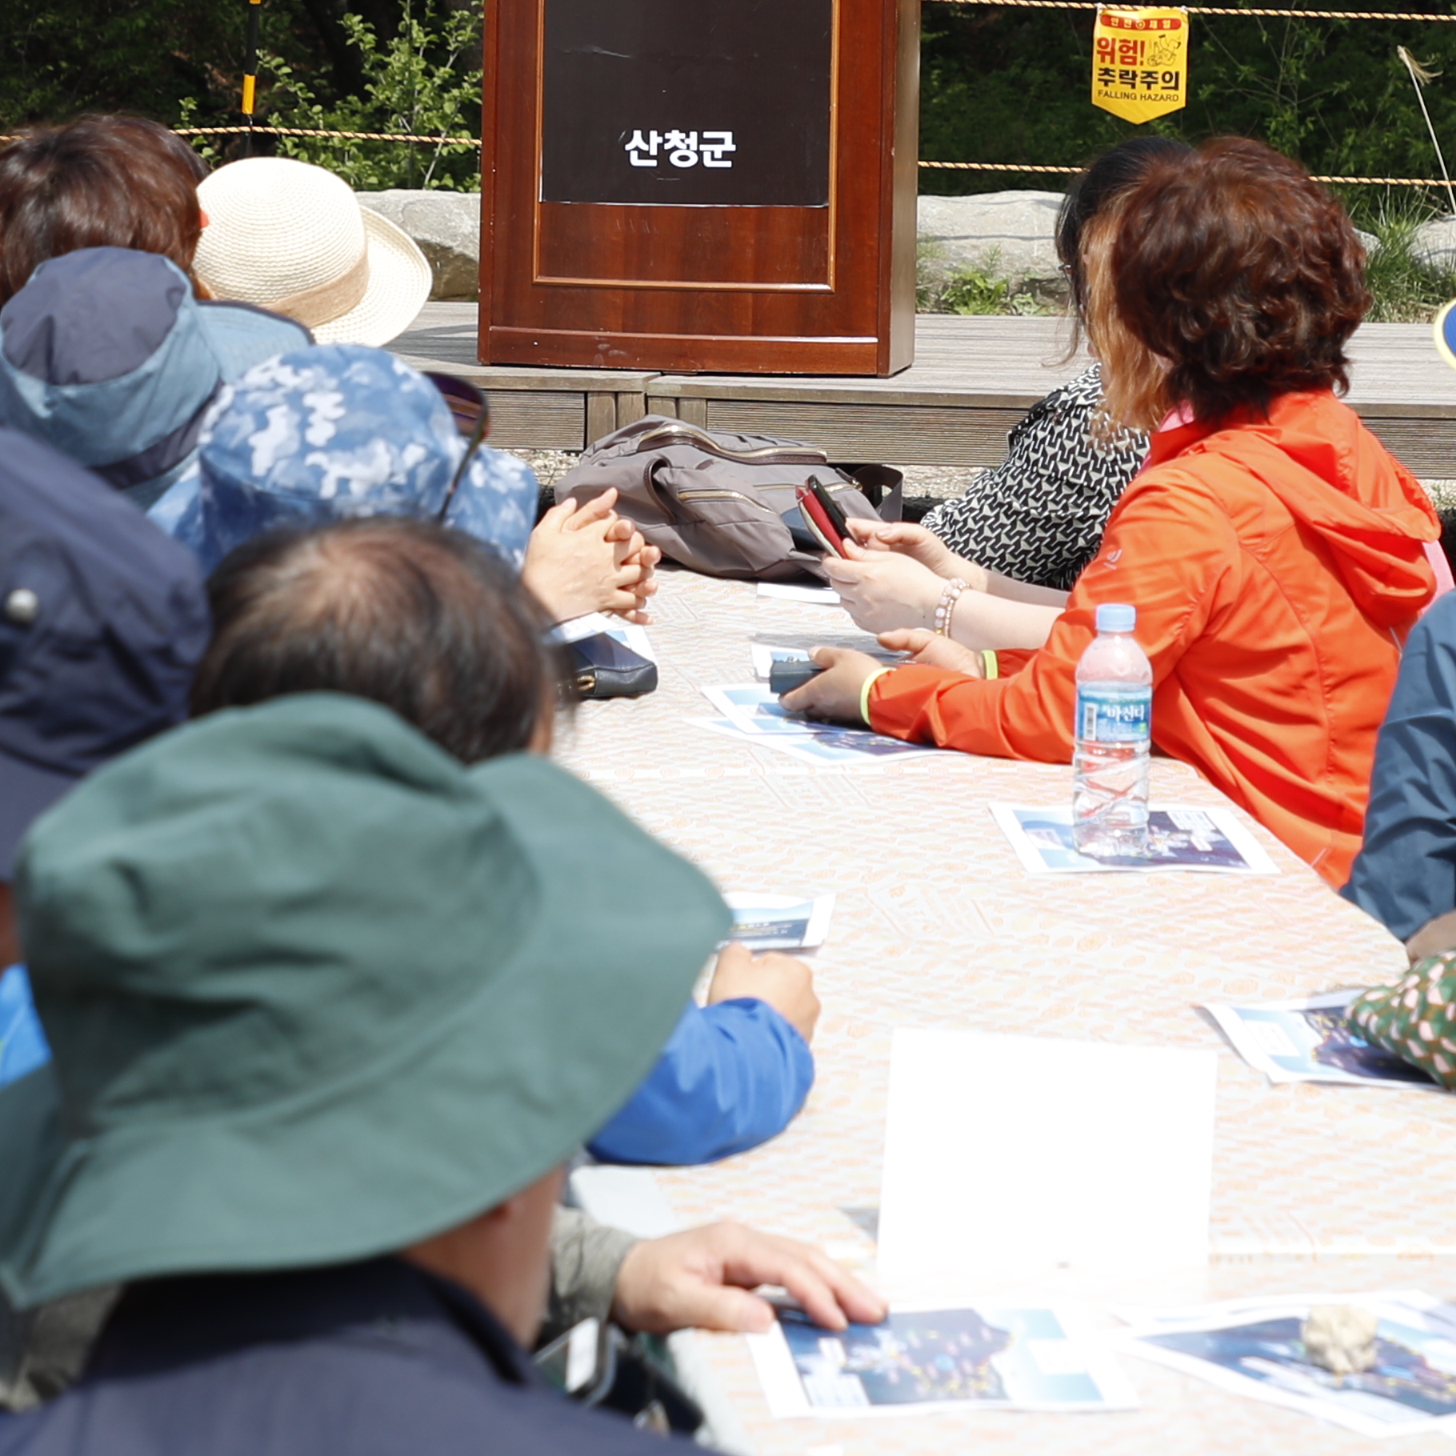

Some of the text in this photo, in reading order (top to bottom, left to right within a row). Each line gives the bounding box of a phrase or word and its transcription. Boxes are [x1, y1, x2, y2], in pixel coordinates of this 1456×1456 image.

[1096, 36, 1146, 67] 위험!
[1097, 67, 1180, 91] 추락주의
[1097, 89, 1180, 102] FALLING HAZARD
[624, 129, 737, 168] 산청군
